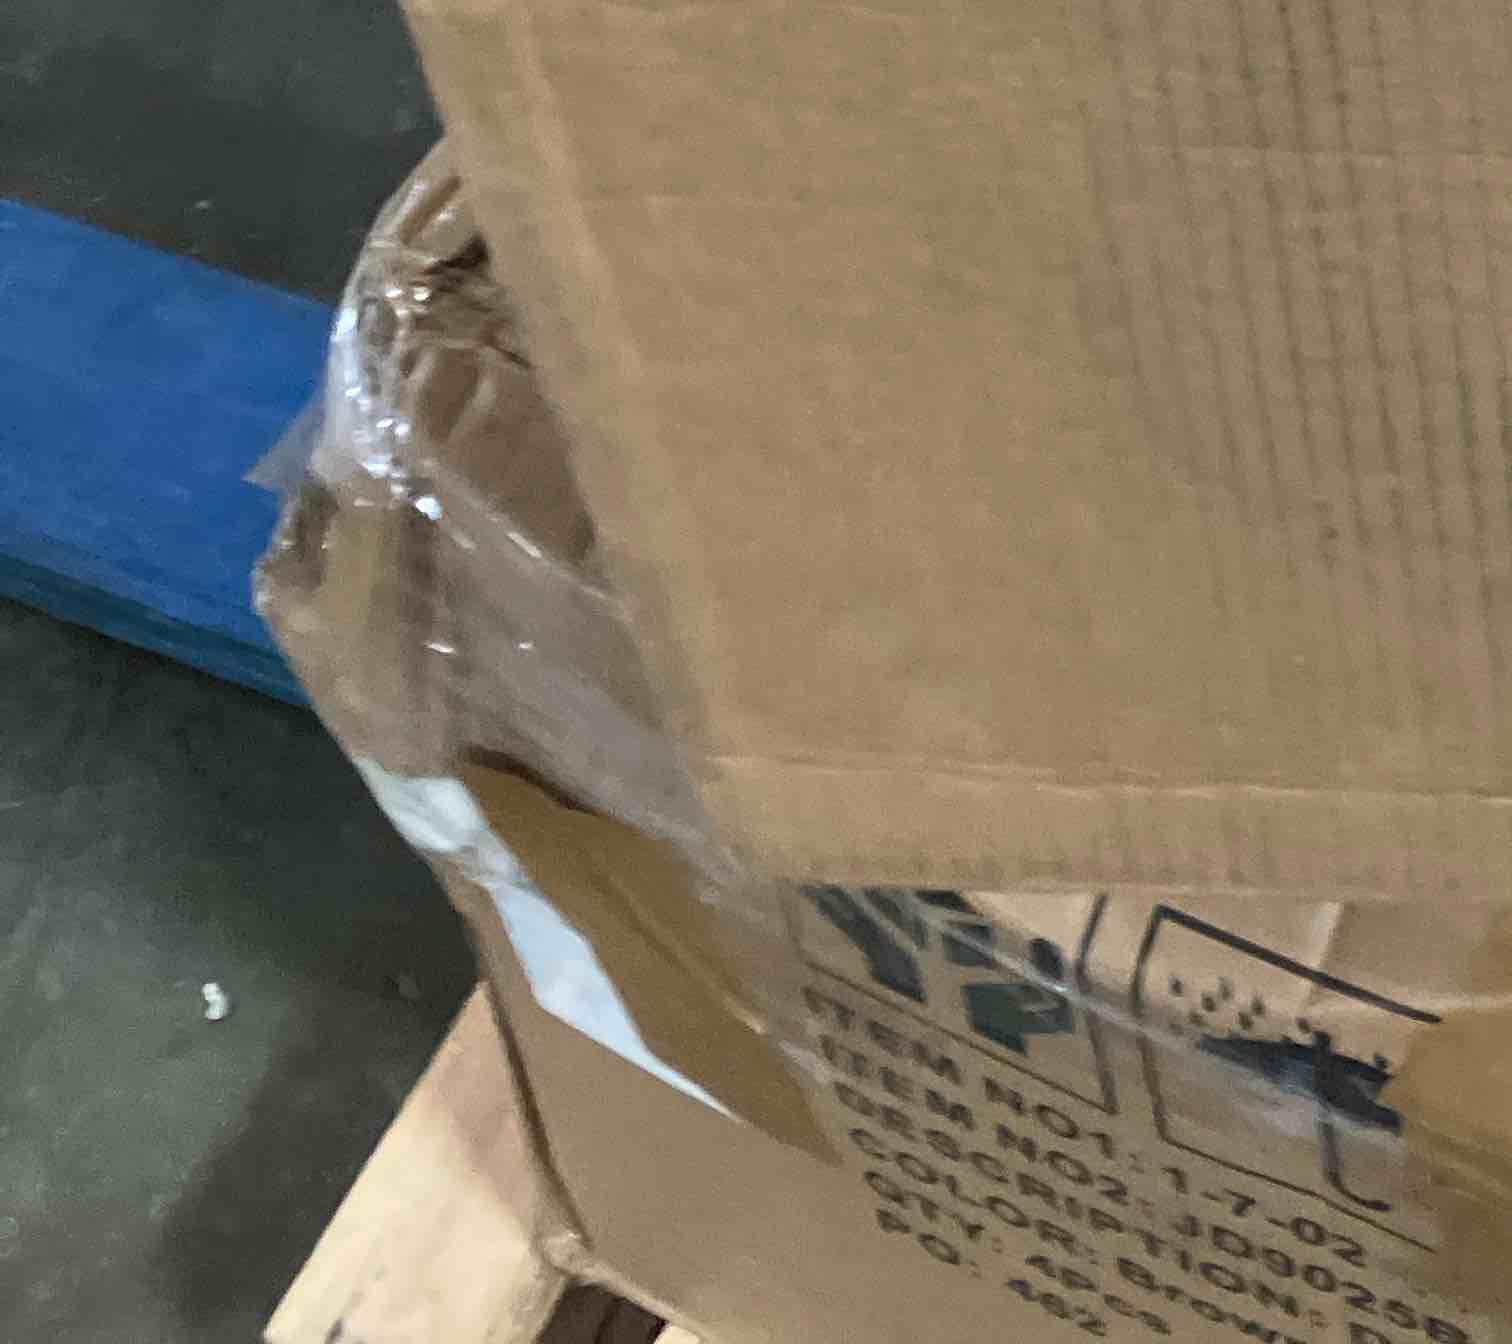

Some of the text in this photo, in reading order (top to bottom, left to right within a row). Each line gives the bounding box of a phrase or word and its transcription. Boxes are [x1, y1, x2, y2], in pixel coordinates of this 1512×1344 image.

[803, 986, 962, 1086] ITEM
[818, 1034, 973, 1130] ITEM
[832, 1080, 1327, 1328] DESCRIPTION:
[848, 1127, 1099, 1265] COLOR:
[864, 1171, 1003, 1253] QTY:
